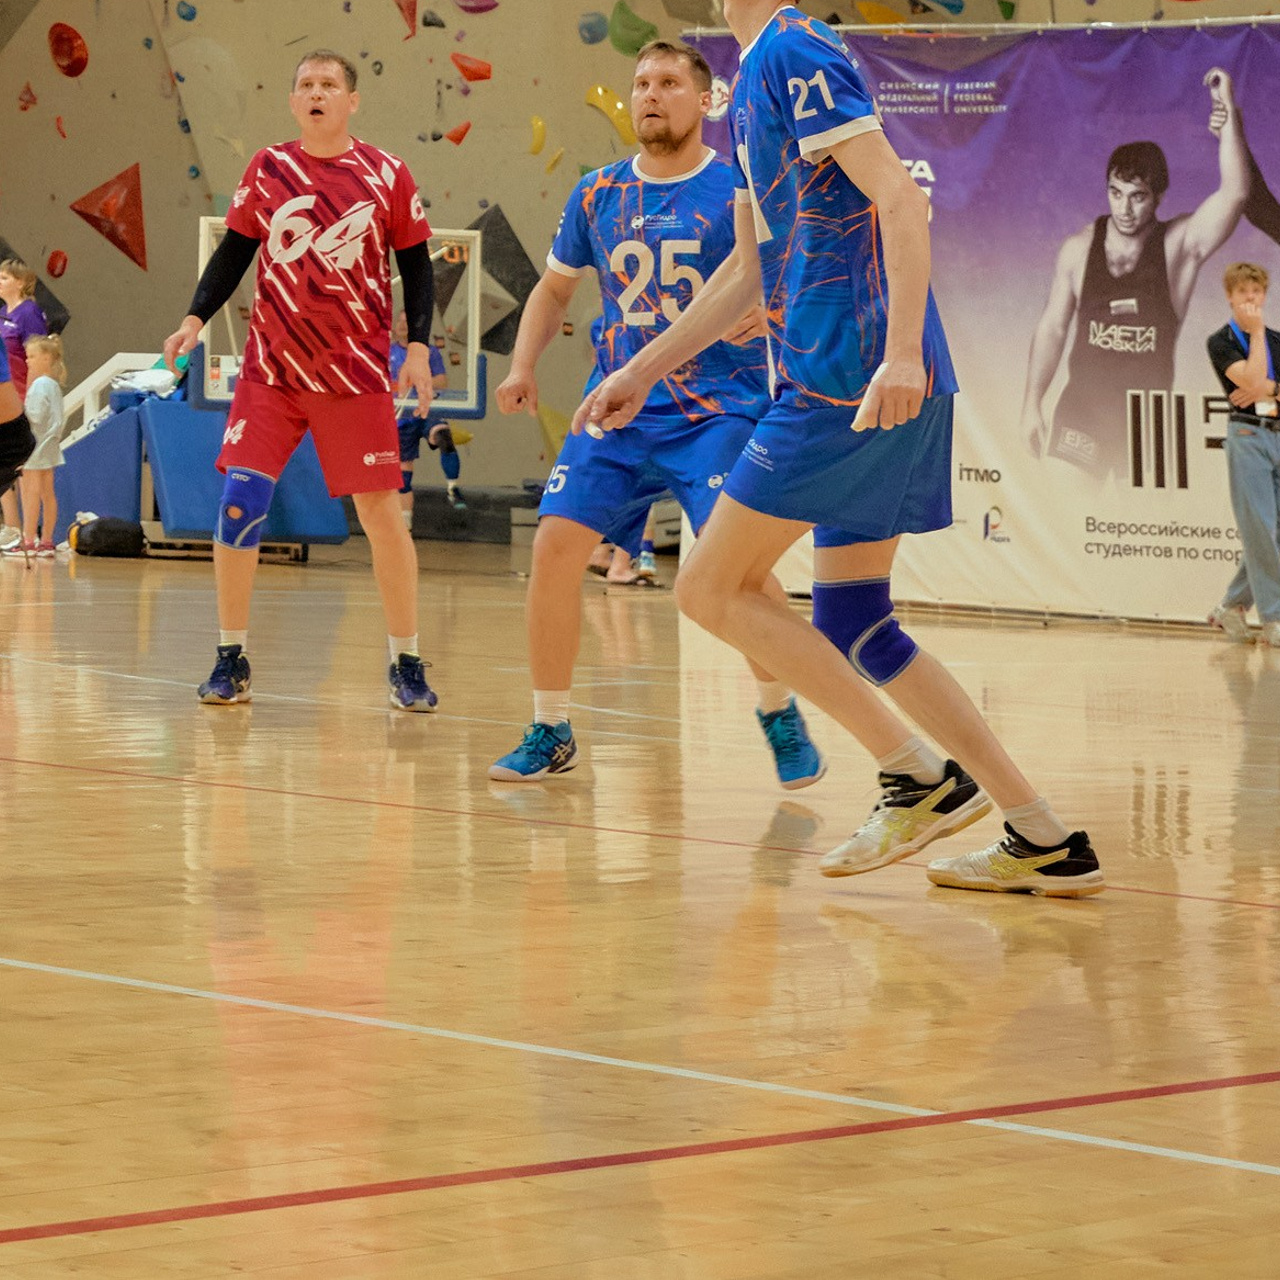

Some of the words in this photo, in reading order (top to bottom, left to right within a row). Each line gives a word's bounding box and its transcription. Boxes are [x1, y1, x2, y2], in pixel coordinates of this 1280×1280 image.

[787, 70, 835, 120] 21
[953, 93, 994, 101] FEDERAL
[267, 194, 376, 269] 64
[610, 240, 704, 326] 25
[1085, 516, 1221, 540] Всероссийские
[1084, 541, 1173, 559] студентов
[1176, 546, 1199, 559] по
[1202, 548, 1243, 566] спор
